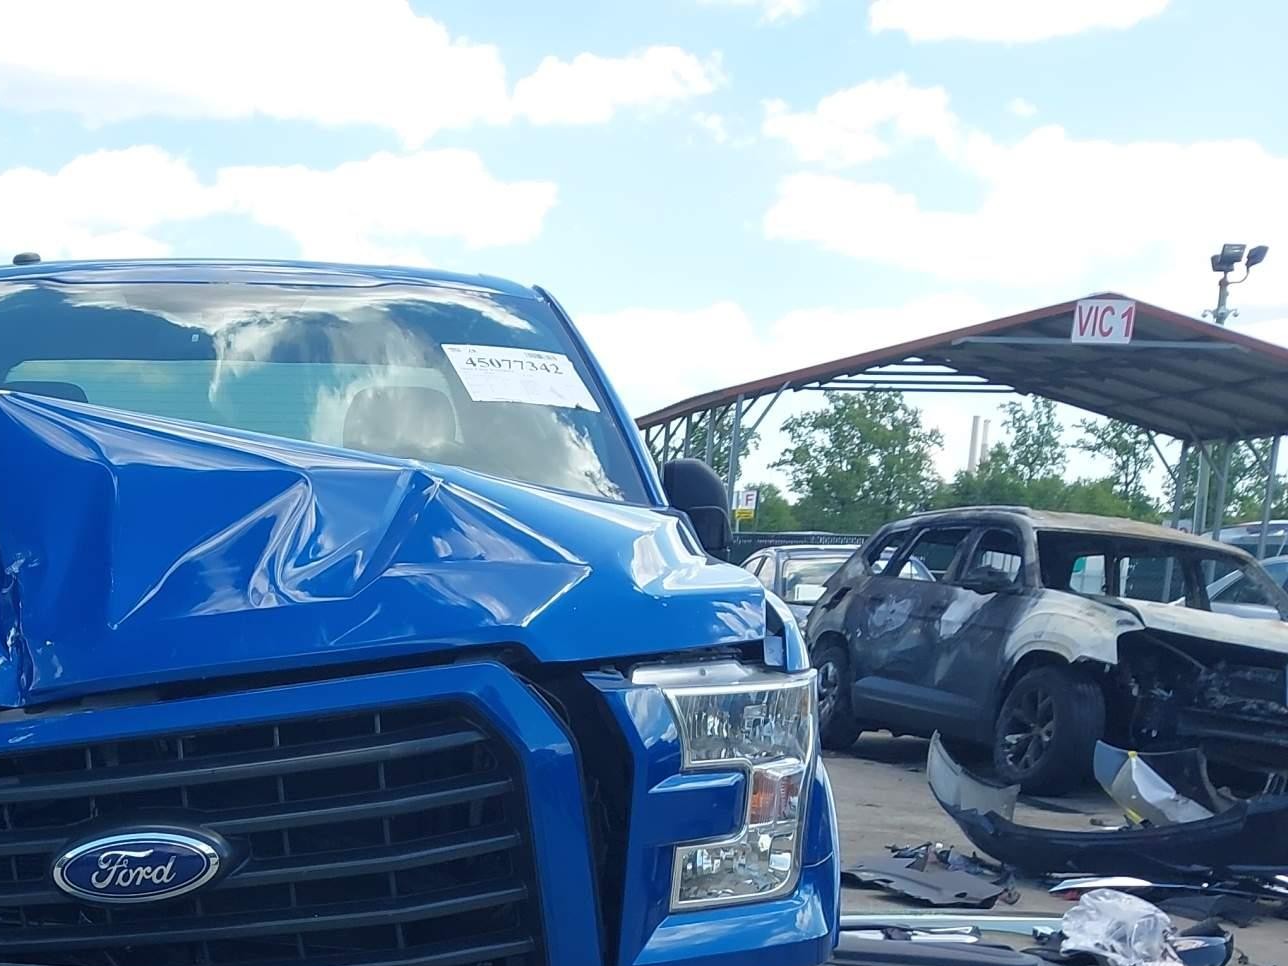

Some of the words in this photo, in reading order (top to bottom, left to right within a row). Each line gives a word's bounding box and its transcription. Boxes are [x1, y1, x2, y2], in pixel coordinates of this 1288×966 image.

[1078, 305, 1115, 338] VIC
[1121, 305, 1134, 338] 1
[464, 356, 564, 375] 45077342
[745, 493, 755, 507] F
[90, 848, 177, 890] Ford
